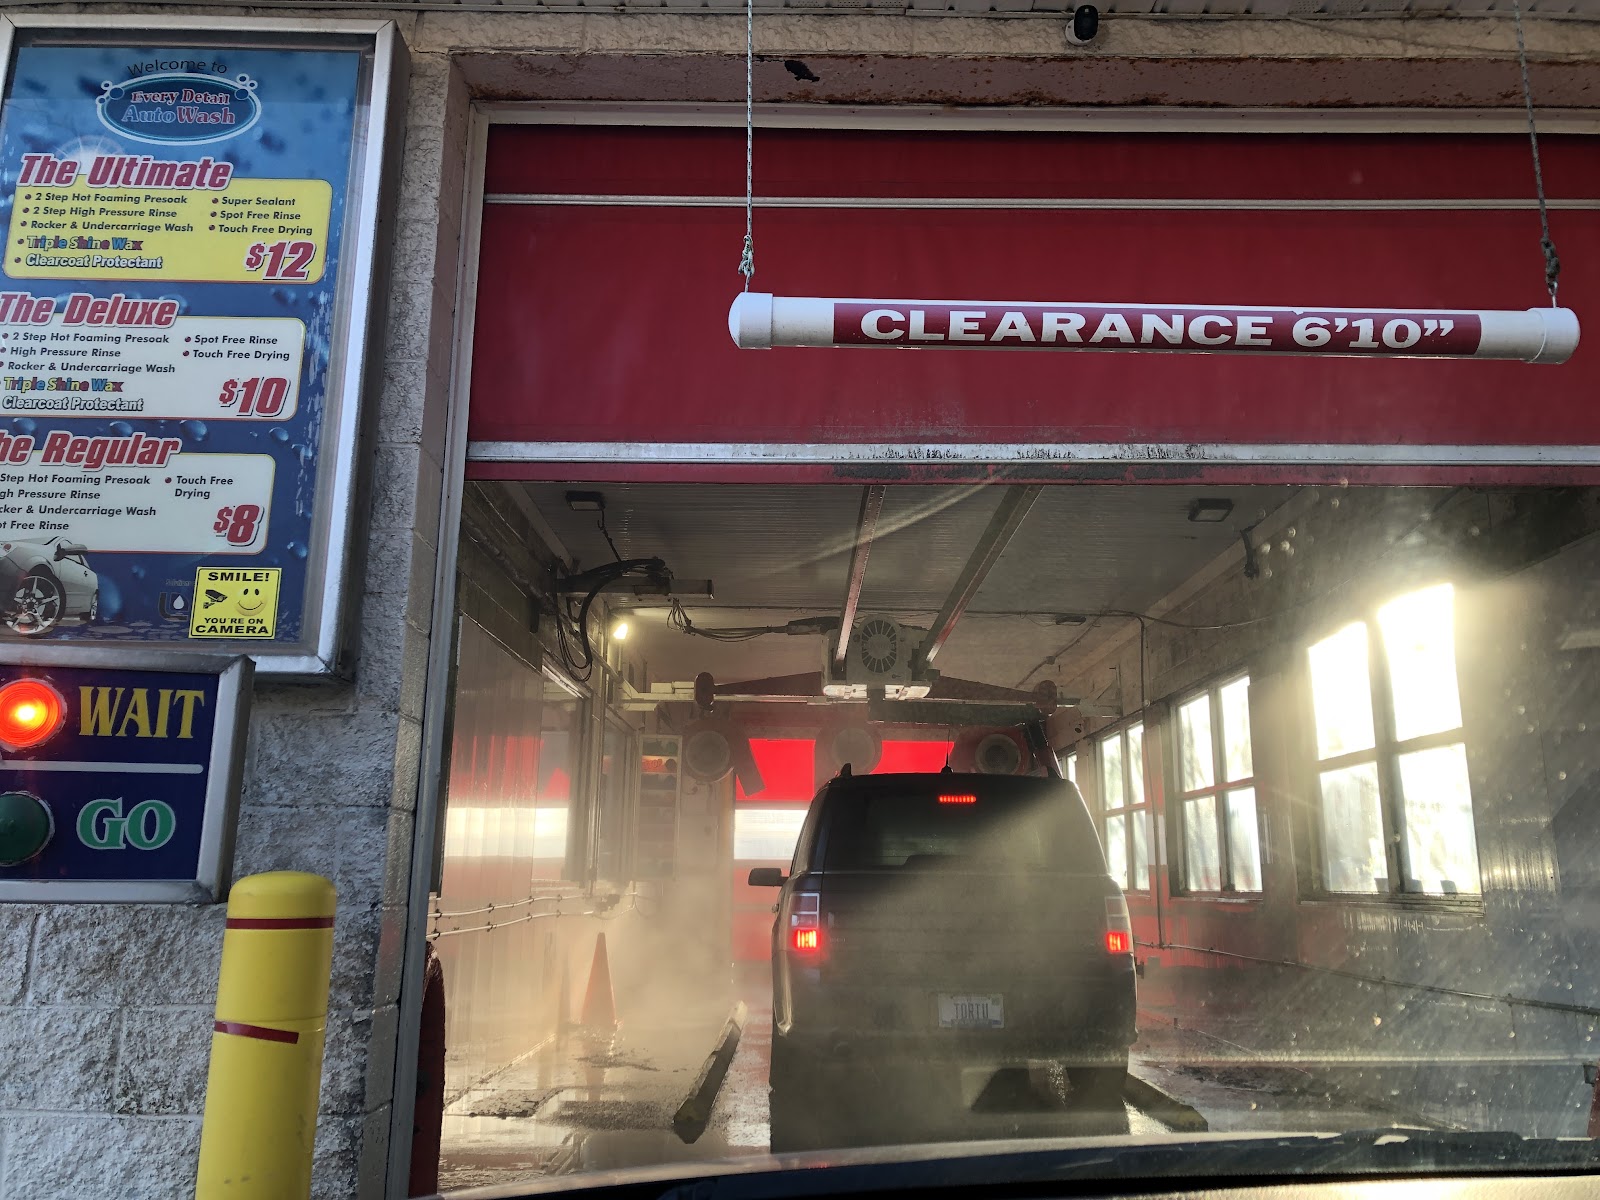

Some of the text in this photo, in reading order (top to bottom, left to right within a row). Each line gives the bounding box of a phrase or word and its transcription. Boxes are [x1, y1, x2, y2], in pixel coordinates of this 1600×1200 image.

[127, 59, 227, 76] Welcome to
[131, 89, 230, 106] Every Detail
[18, 155, 231, 188] The Ultimate
[35, 193, 188, 205] 2 Step Hot Foaming Presoak
[222, 197, 295, 206] Super Sealant
[33, 206, 177, 218] 2 Step High Pressure Rinse
[220, 211, 301, 220] Spot Free Rinse
[31, 221, 193, 233] Rocker & Undercarriage Wash
[218, 224, 313, 235] Touch Free Drying
[27, 235, 144, 251] Triple Shine Wax
[26, 253, 163, 269] Clearcoat Protectant
[245, 241, 315, 279] $12
[0, 293, 178, 326] The Deluxe
[860, 309, 1273, 346] CLEARANCE
[12, 332, 170, 344] 2 Step Hot Foaming Presoak
[194, 335, 278, 345] Spot Free Rinse
[10, 347, 121, 357] High Pressure Rinse
[193, 350, 290, 361] Touch Free Drying
[8, 362, 176, 374] Rocker & Undercarriage Wash
[3, 376, 124, 393] Triple Shine Wax
[218, 377, 289, 415] $10
[2, 396, 144, 412] Clearcoat Protectant
[0, 432, 181, 469] he Regular
[0, 473, 151, 486] Step Hot Foaming Presoak
[176, 475, 234, 485] Touch Free
[17, 489, 66, 499] Pressure
[70, 490, 101, 499] Rinse
[174, 488, 211, 499] Drying
[26, 505, 34, 514] &
[38, 505, 122, 517] Undercarriage
[126, 506, 156, 516] Wash
[10, 521, 35, 530] Free
[39, 521, 70, 530] Rinse
[213, 504, 262, 545] $8
[208, 572, 270, 582] SMILE!
[195, 625, 269, 634] CAMERA
[78, 686, 205, 739] WAIT
[76, 797, 176, 851] GO
